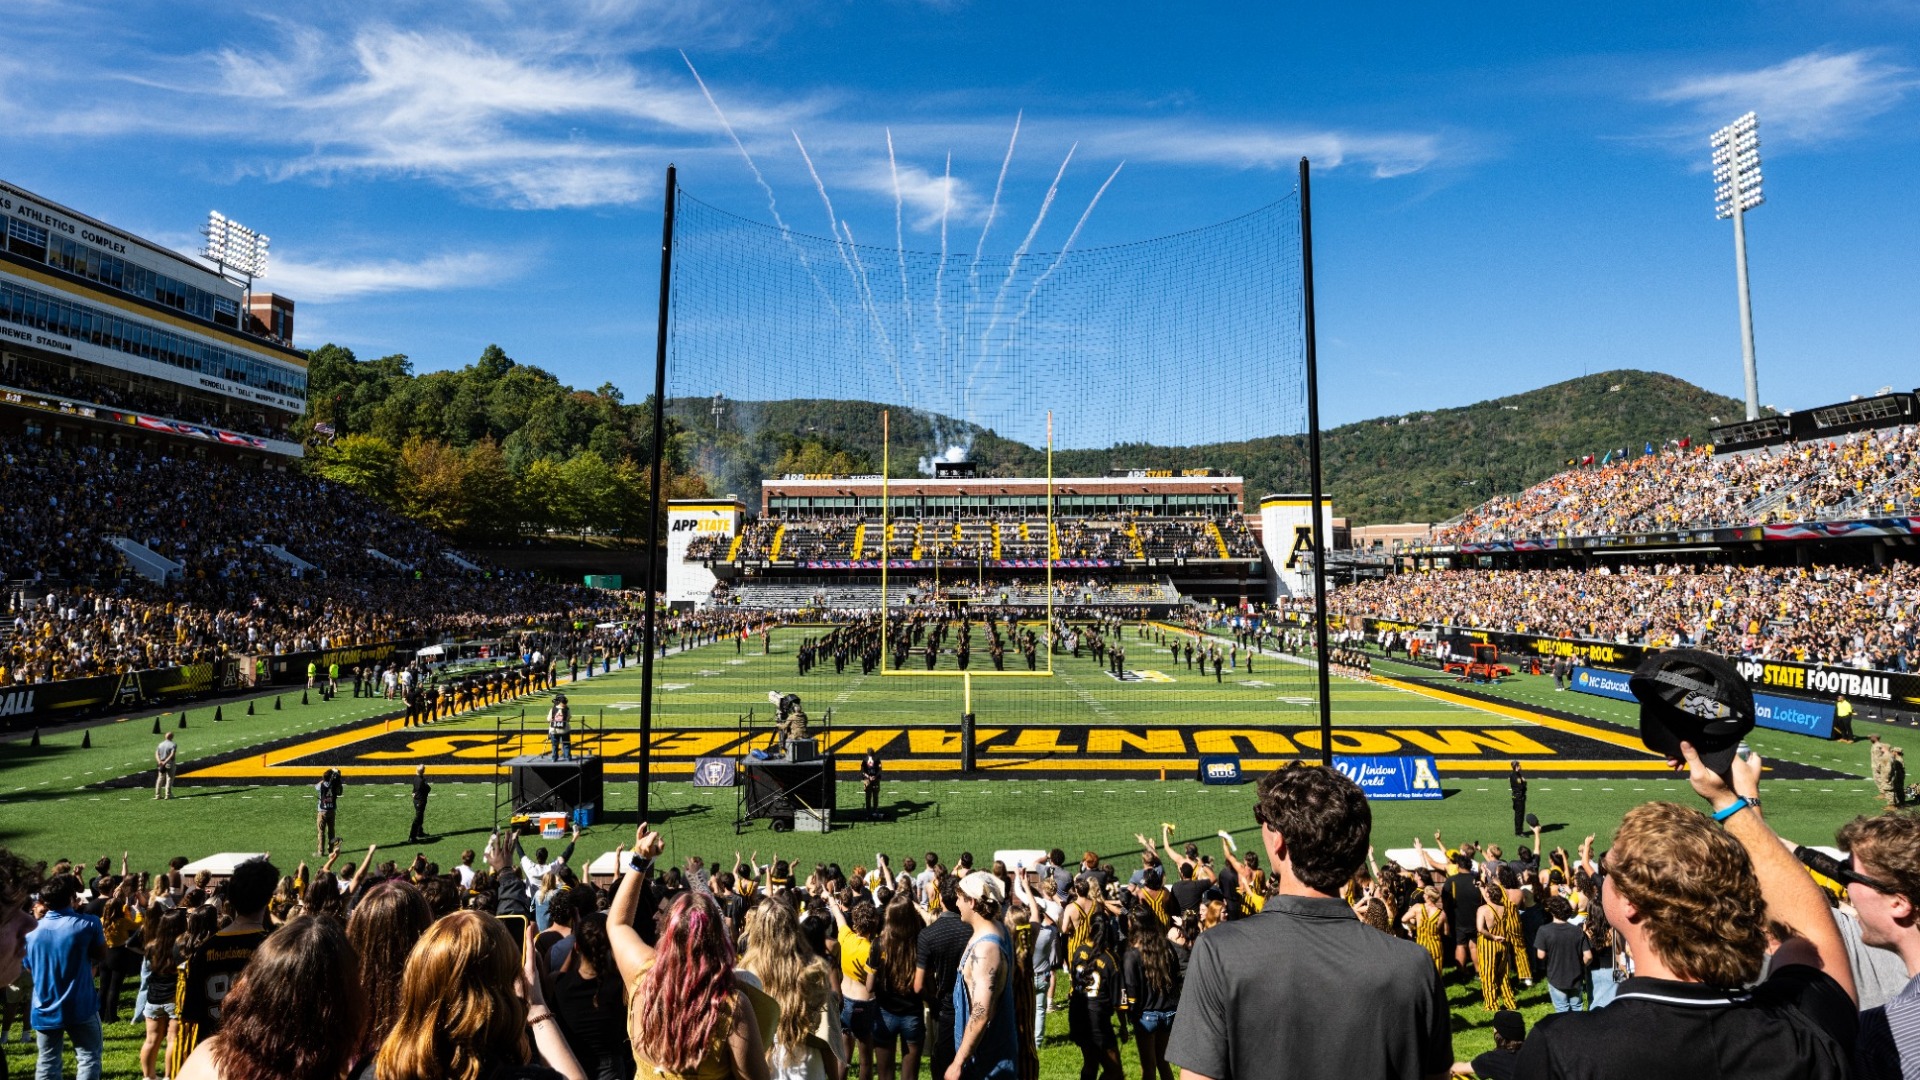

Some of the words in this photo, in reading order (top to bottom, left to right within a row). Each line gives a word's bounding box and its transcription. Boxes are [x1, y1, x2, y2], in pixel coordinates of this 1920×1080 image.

[18, 205, 75, 234] ATHLETICS
[81, 229, 126, 254] COMPLEX
[0, 326, 33, 341] REWER
[36, 335, 72, 351] STADIUM
[323, 649, 361, 667] WELCOME
[1537, 639, 1573, 657] WELCOME
[1590, 645, 1614, 662] ROCK
[1589, 676, 1600, 687] NC
[1737, 661, 1763, 682] APP
[1764, 664, 1805, 689] STATE
[1807, 669, 1892, 701] FOOTBALL
[0, 690, 34, 716] ALL
[1773, 706, 1820, 729] Lottery
[1207, 762, 1237, 778] SBC
[1413, 759, 1440, 789] A
